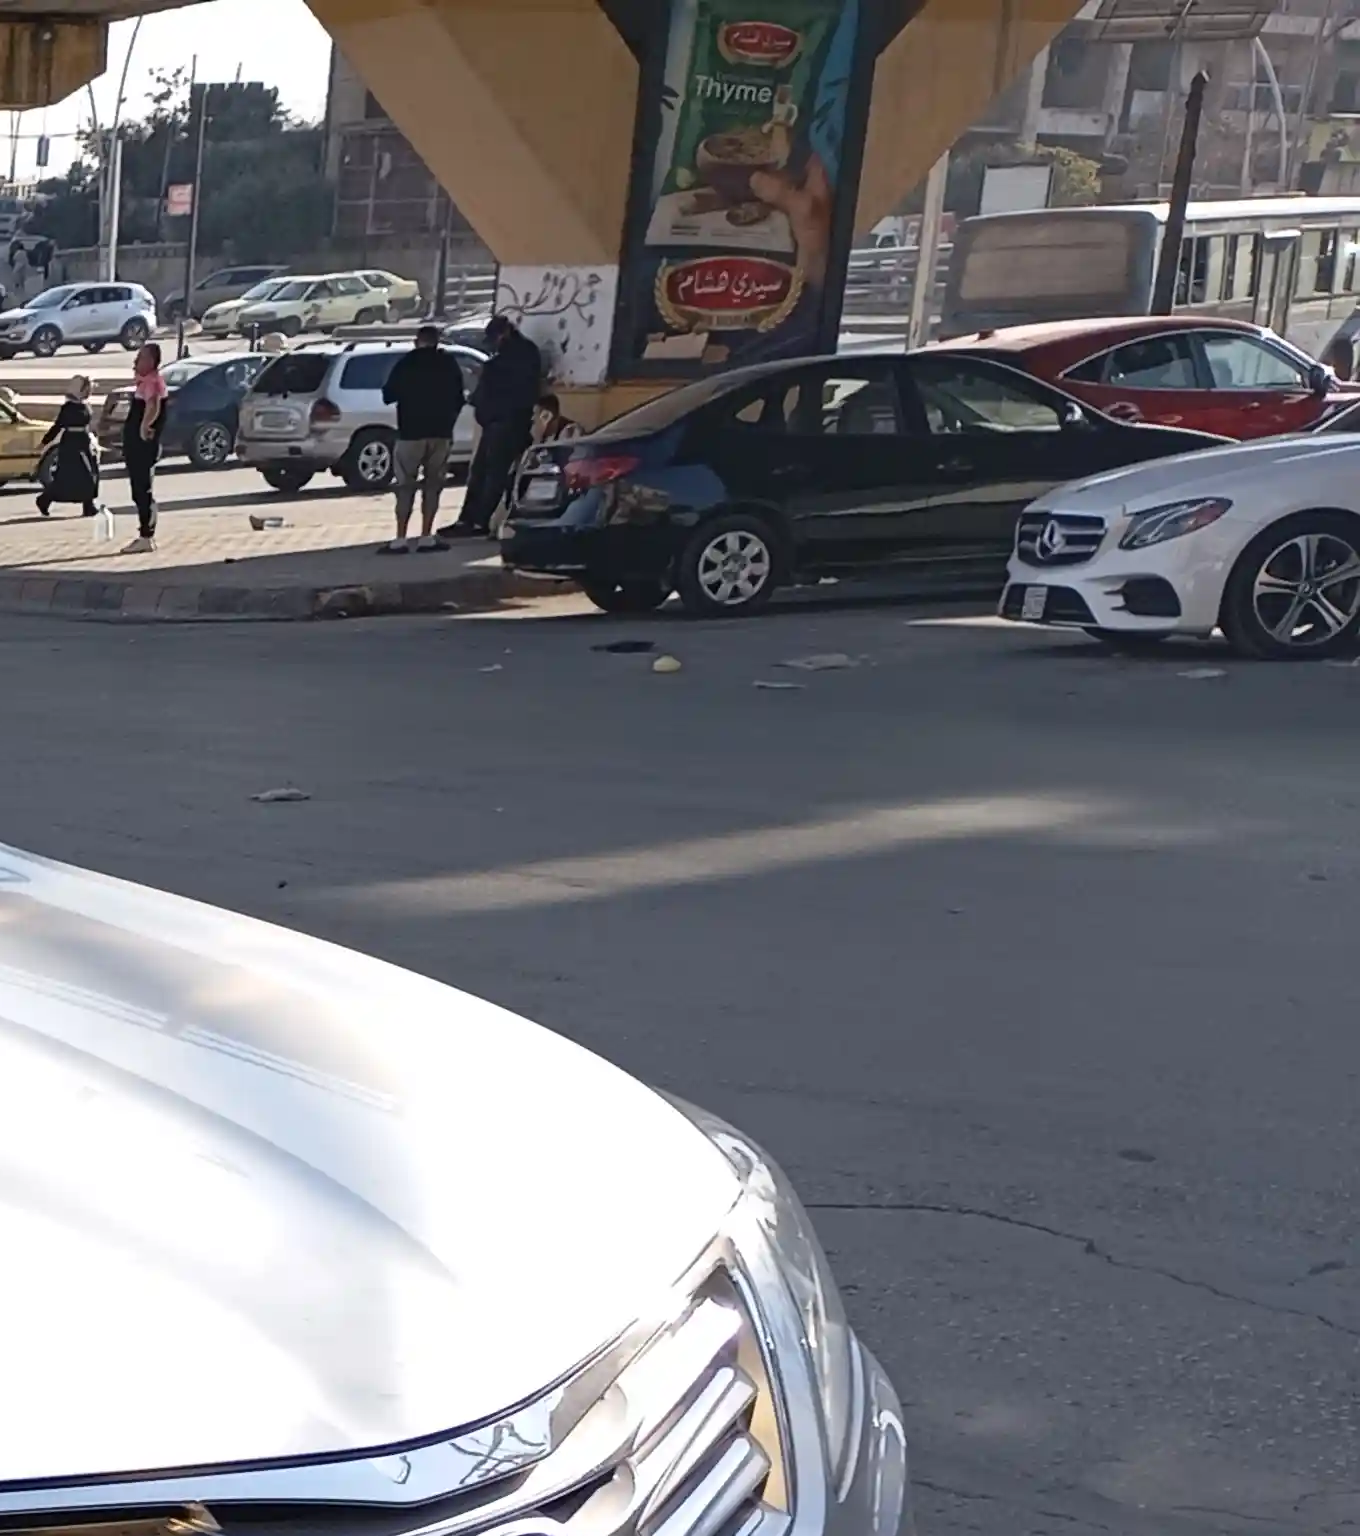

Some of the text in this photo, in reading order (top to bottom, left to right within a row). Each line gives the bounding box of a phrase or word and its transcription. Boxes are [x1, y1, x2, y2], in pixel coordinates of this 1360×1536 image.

[695, 75, 772, 104] Thyme
[677, 269, 783, 303] سيدي هشام
